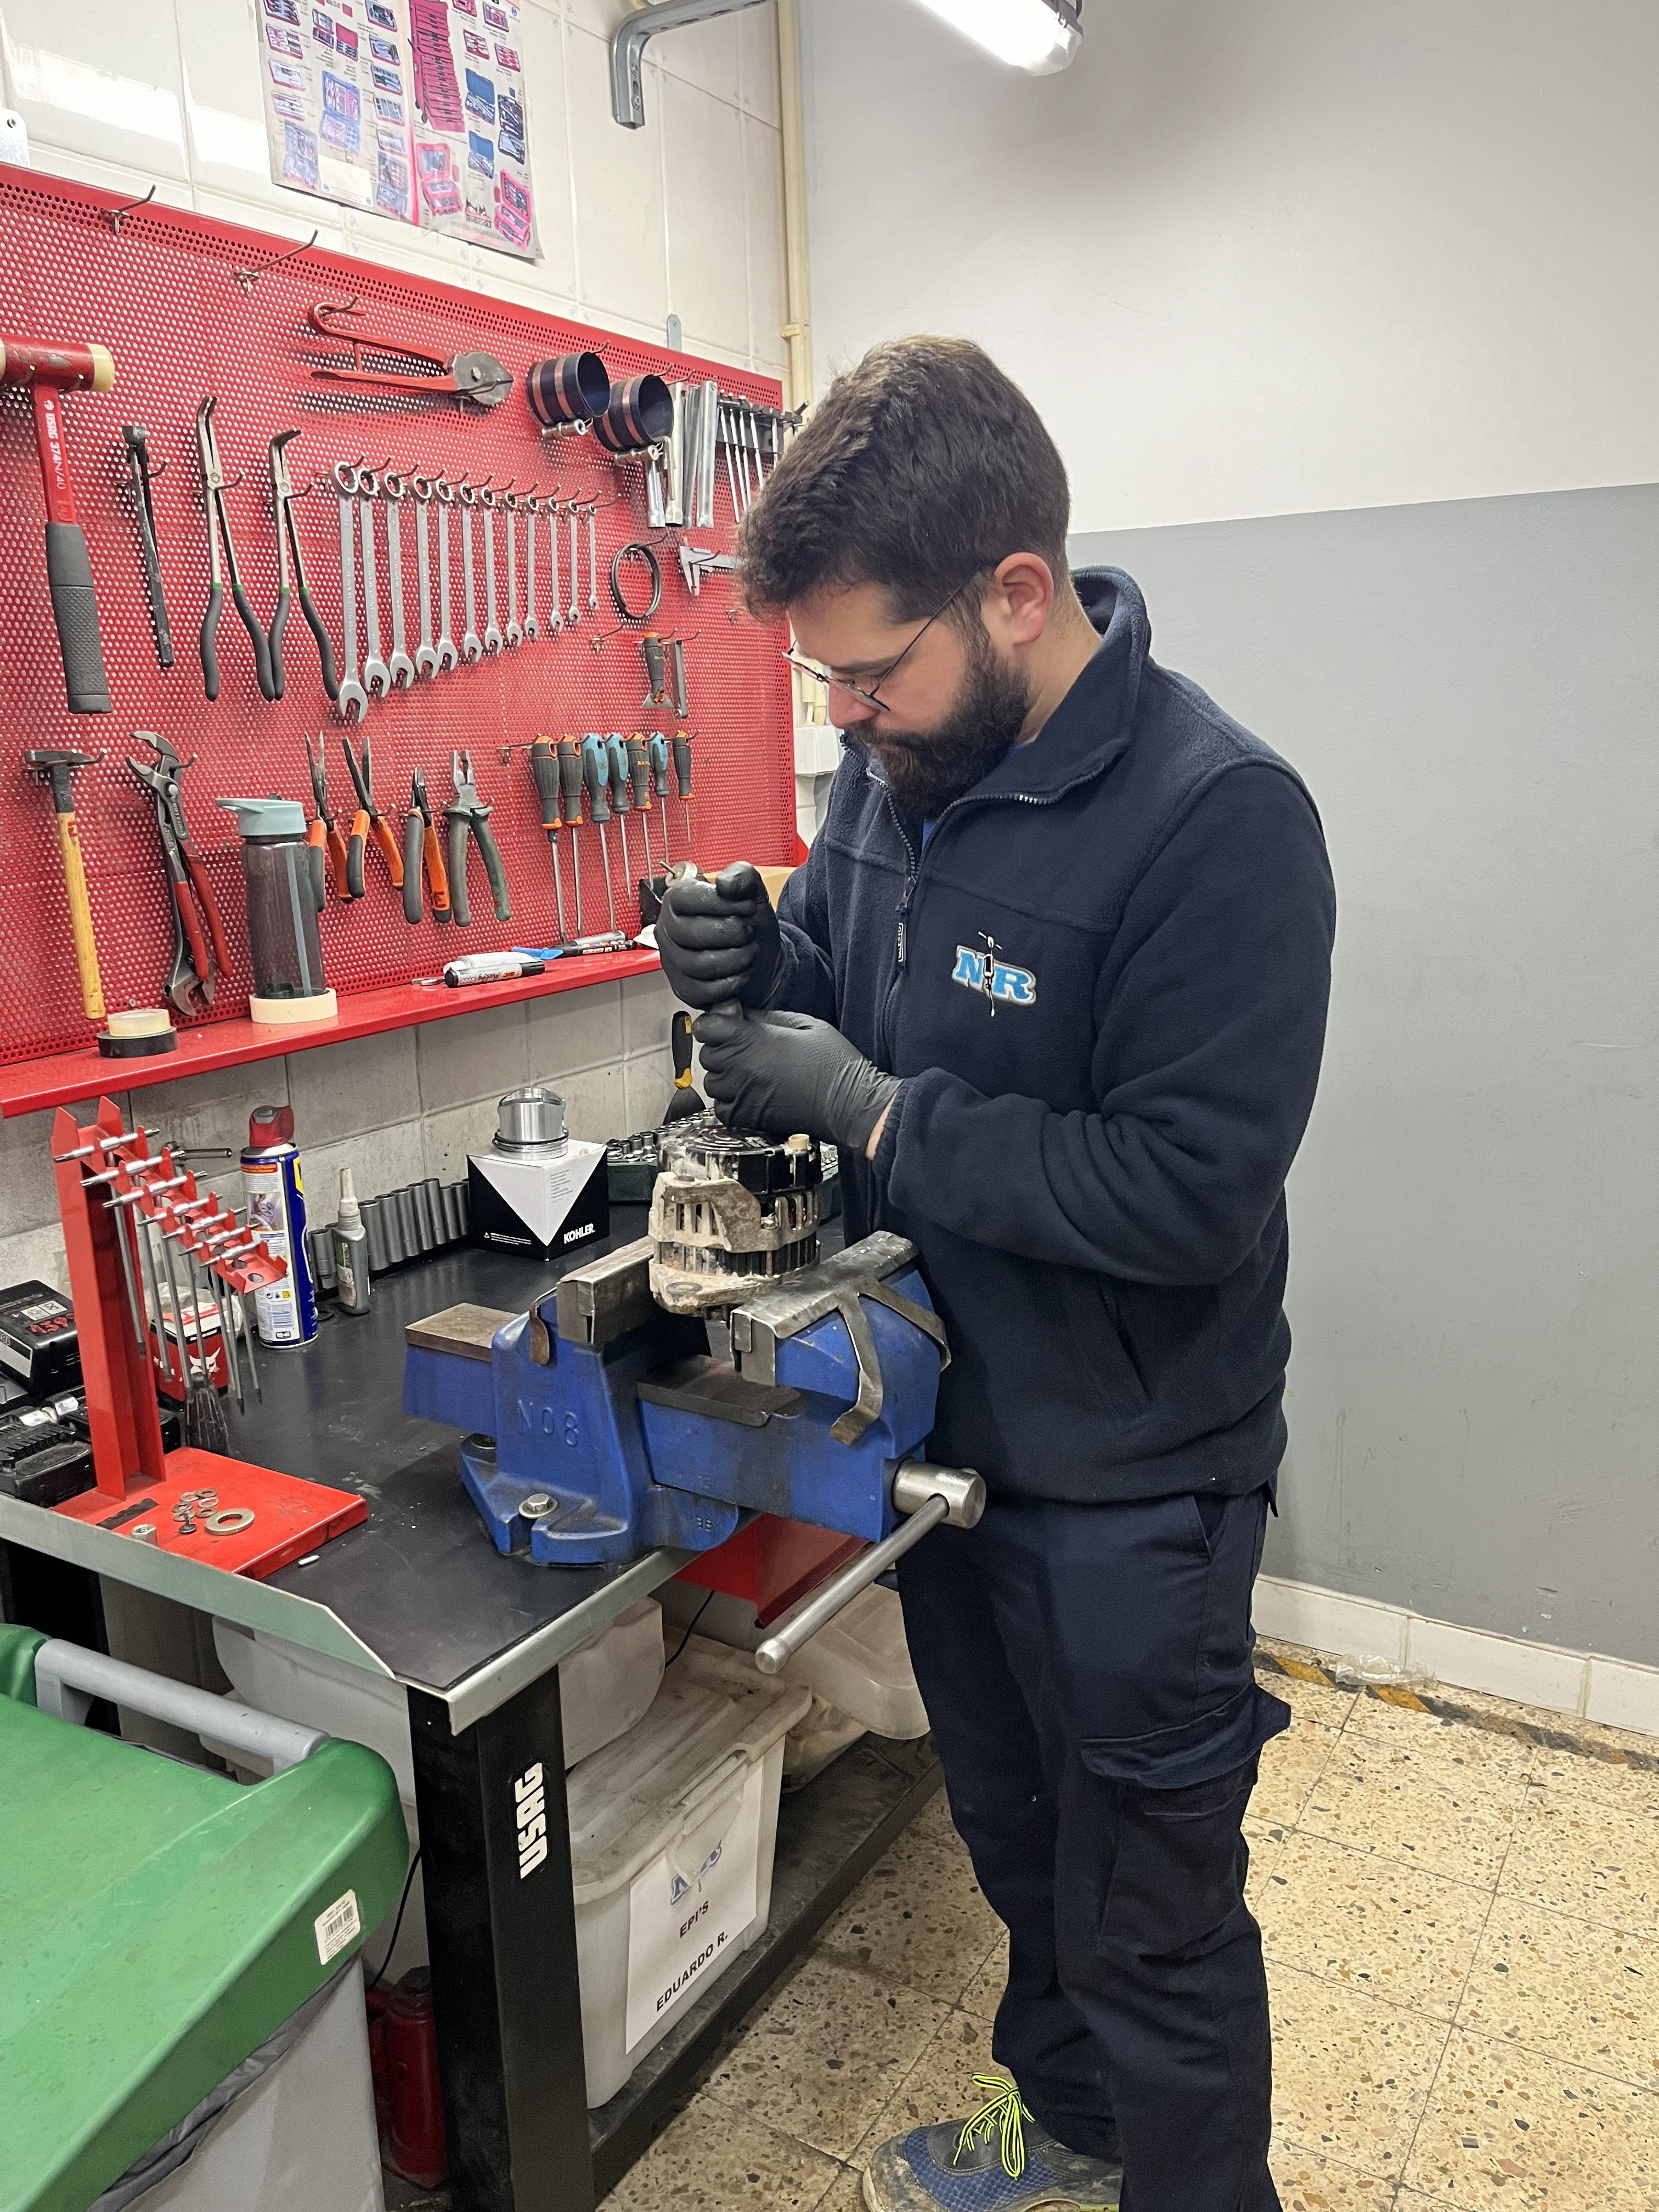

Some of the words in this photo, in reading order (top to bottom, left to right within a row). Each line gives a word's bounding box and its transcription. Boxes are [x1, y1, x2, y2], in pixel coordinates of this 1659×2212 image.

[563, 1223, 594, 1244] KOHLER
[515, 1762, 548, 1879] USAG
[680, 1900, 709, 1938] EPI'S
[657, 1943, 714, 2012] EDUARDO
[717, 1931, 728, 1947] R.
